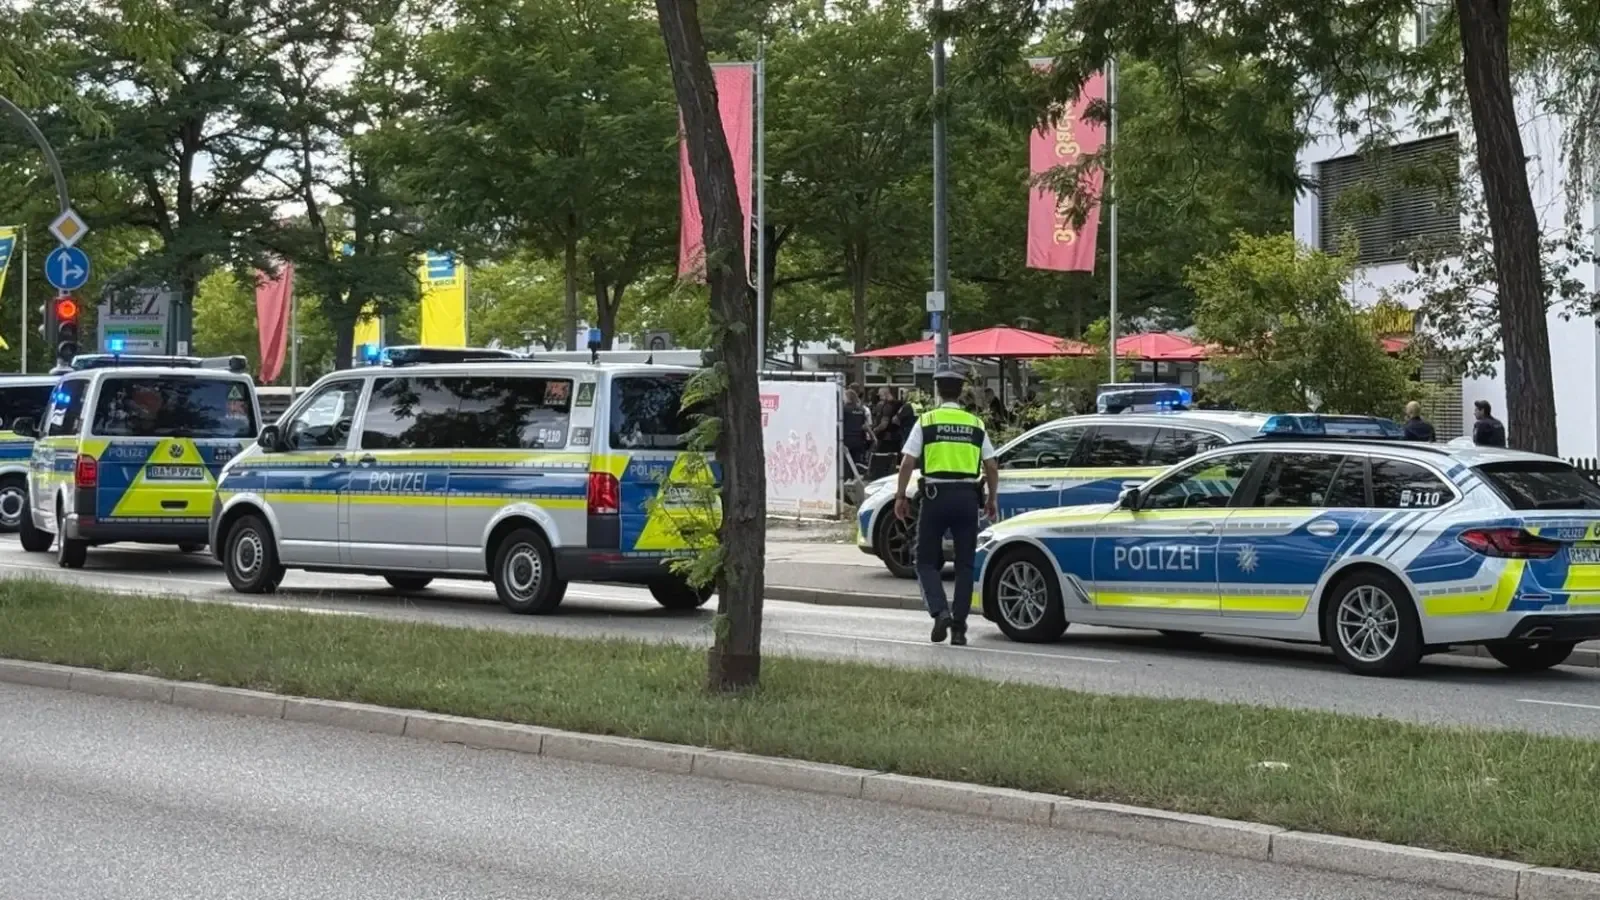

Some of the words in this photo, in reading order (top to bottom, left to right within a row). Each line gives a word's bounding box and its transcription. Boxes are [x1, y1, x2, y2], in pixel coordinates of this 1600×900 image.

[547, 430, 561, 442] 110
[937, 425, 974, 435] POLIZEI
[108, 447, 148, 459] POLIZEI
[368, 471, 428, 492] POLIZEI
[1414, 492, 1440, 506] 110
[1557, 527, 1585, 538] POLIZEI
[1114, 546, 1200, 570] POLIZEI
